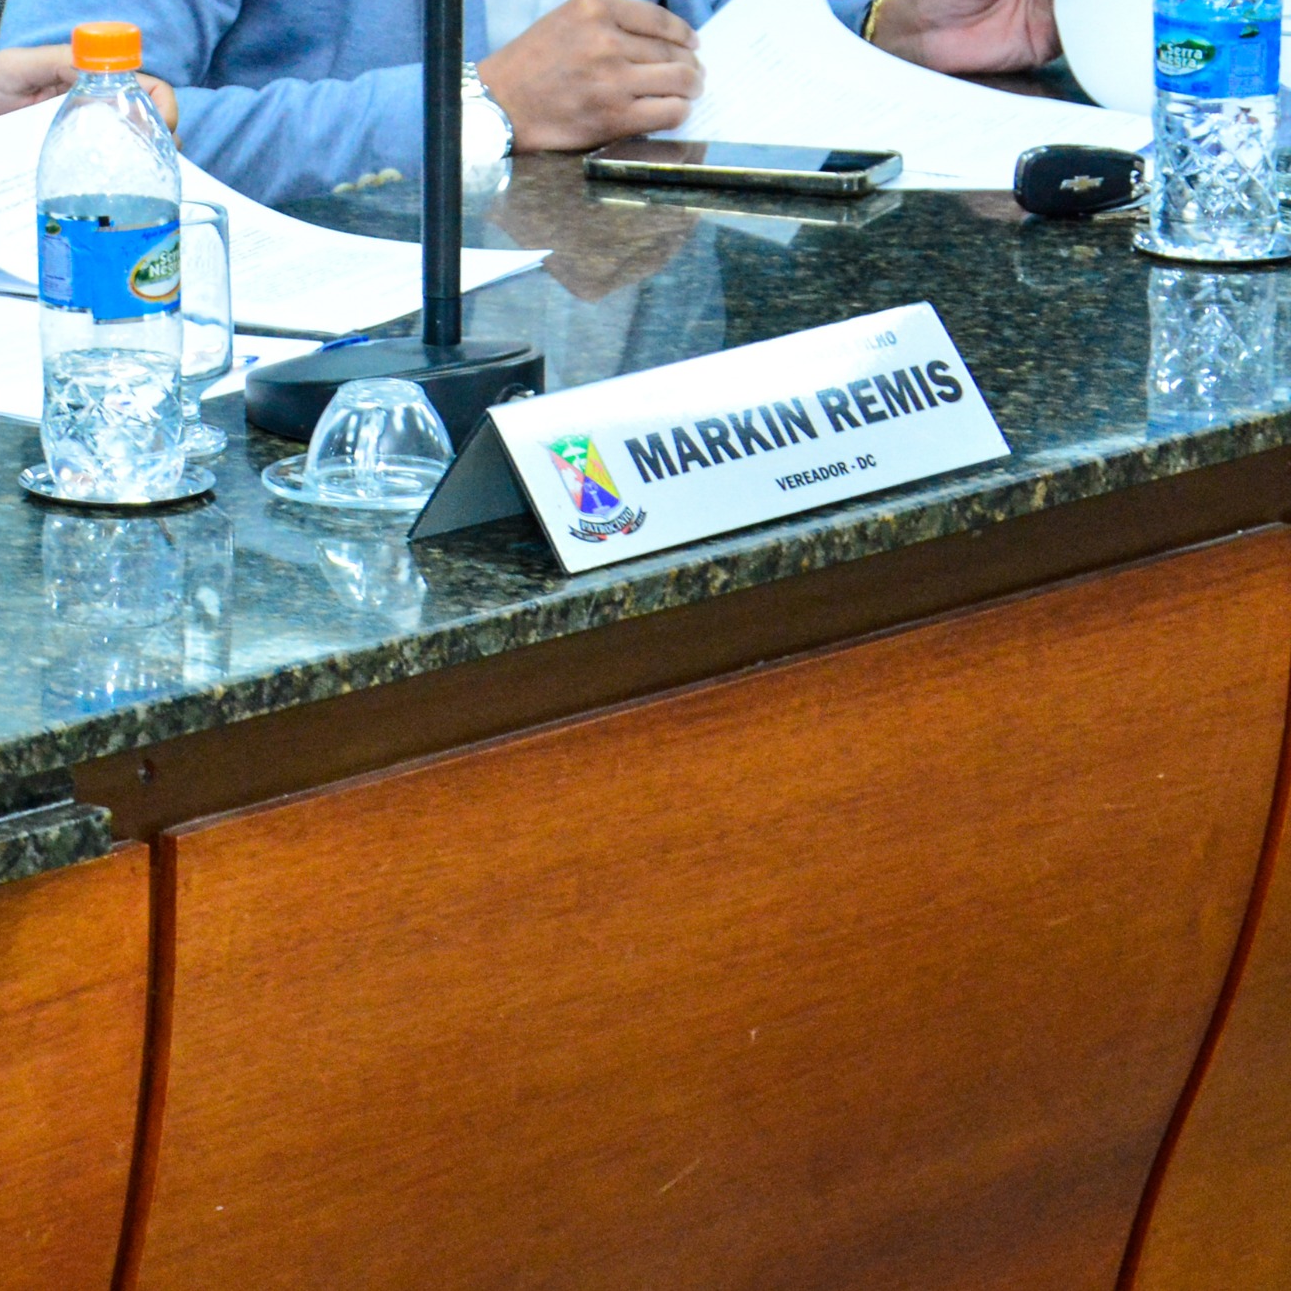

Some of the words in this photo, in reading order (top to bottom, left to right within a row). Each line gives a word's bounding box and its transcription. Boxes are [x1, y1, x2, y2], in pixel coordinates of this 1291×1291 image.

[623, 397, 818, 484] MARKIN
[816, 360, 963, 433] REMIS
[776, 462, 850, 491] VEREADOR
[857, 454, 877, 469] DC
